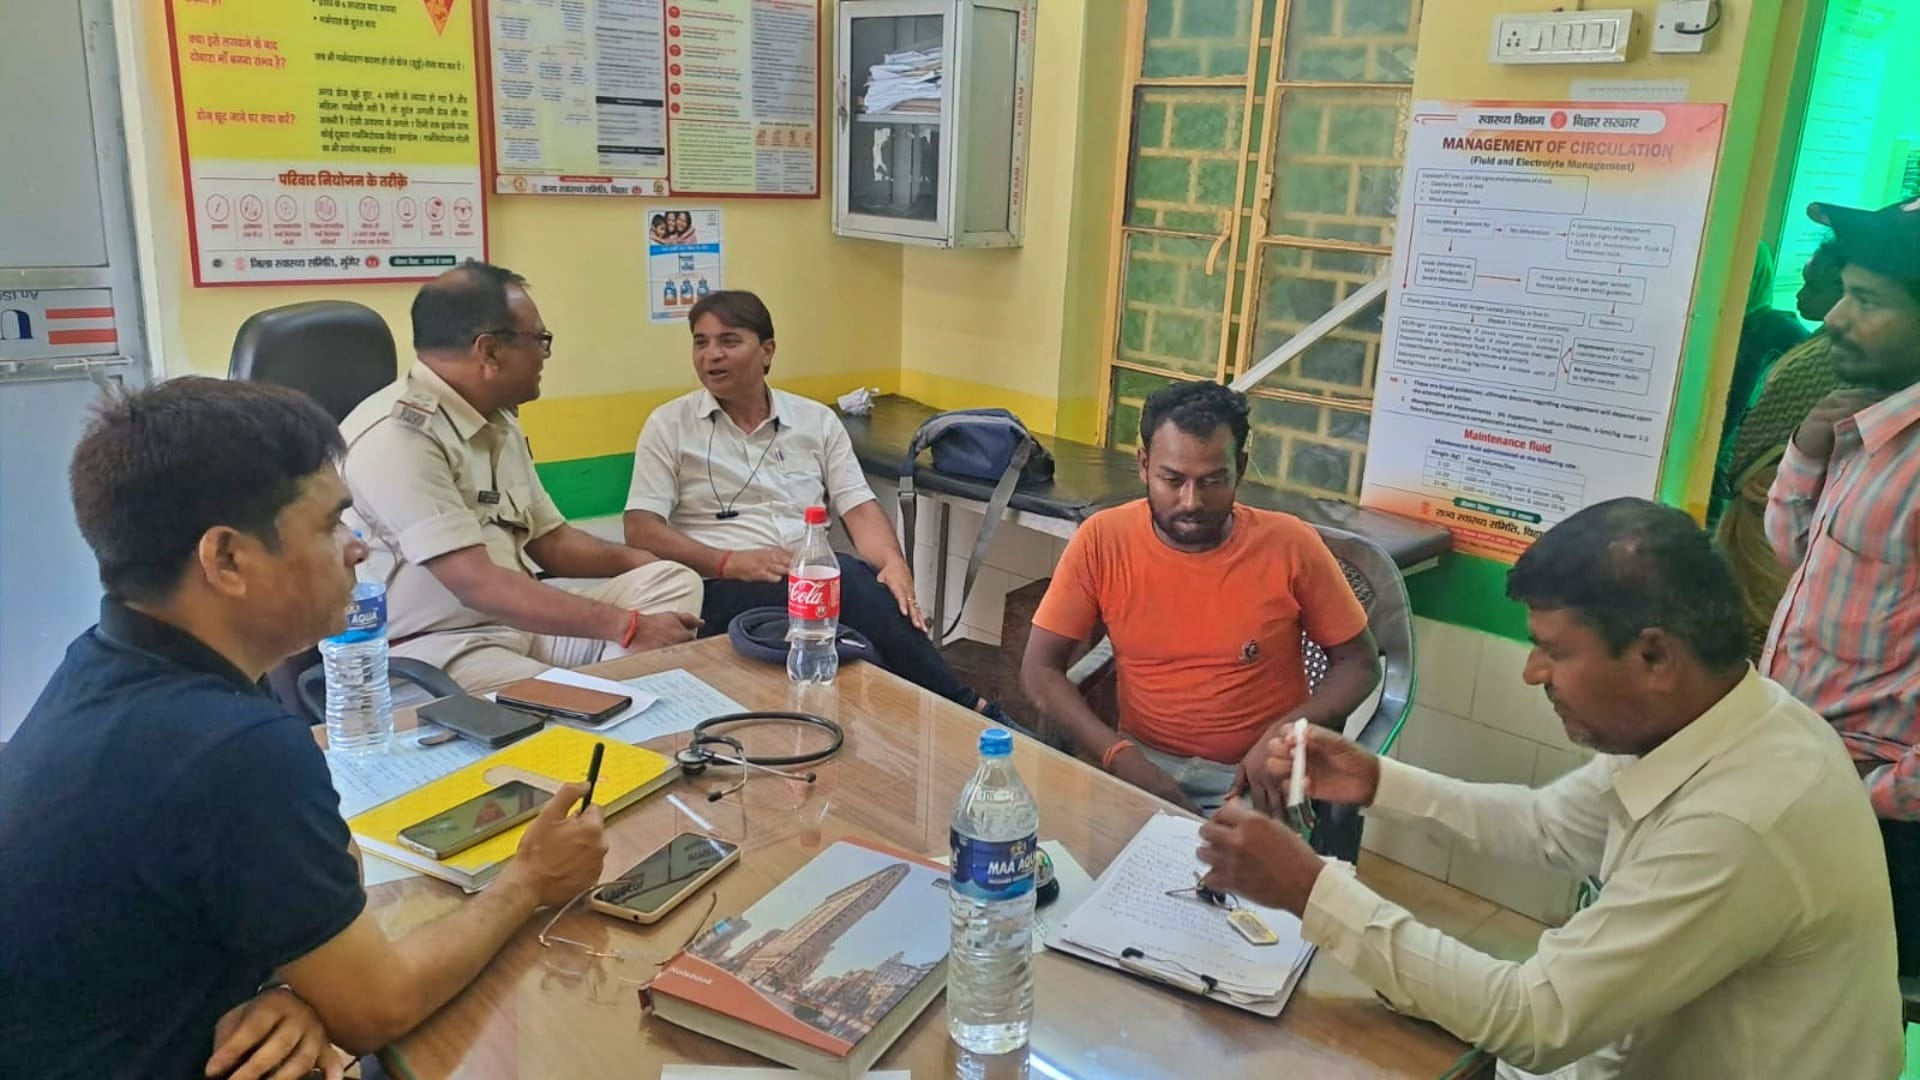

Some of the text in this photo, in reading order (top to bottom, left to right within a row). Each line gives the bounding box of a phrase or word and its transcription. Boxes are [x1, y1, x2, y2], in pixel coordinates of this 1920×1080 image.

[1478, 112, 1640, 128] स्वास्थ्य विभाग बिहार सरकार
[1442, 136, 1675, 158] MANAGEMENT OF CIRCULATION
[1470, 155, 1635, 173] (Fluid and Electrolyte Management)
[279, 169, 316, 187] परिवार
[318, 170, 364, 187] नियोजन
[366, 172, 378, 187] के
[250, 257, 273, 268] जिला
[275, 258, 306, 268] स्वास्थ्य
[1463, 428, 1553, 454] Maintenance fluid
[1435, 508, 1455, 520] राज्य
[1457, 513, 1487, 527] स्वास्थ्य
[791, 580, 826, 605] Cola
[987, 861, 1015, 875] MAA
